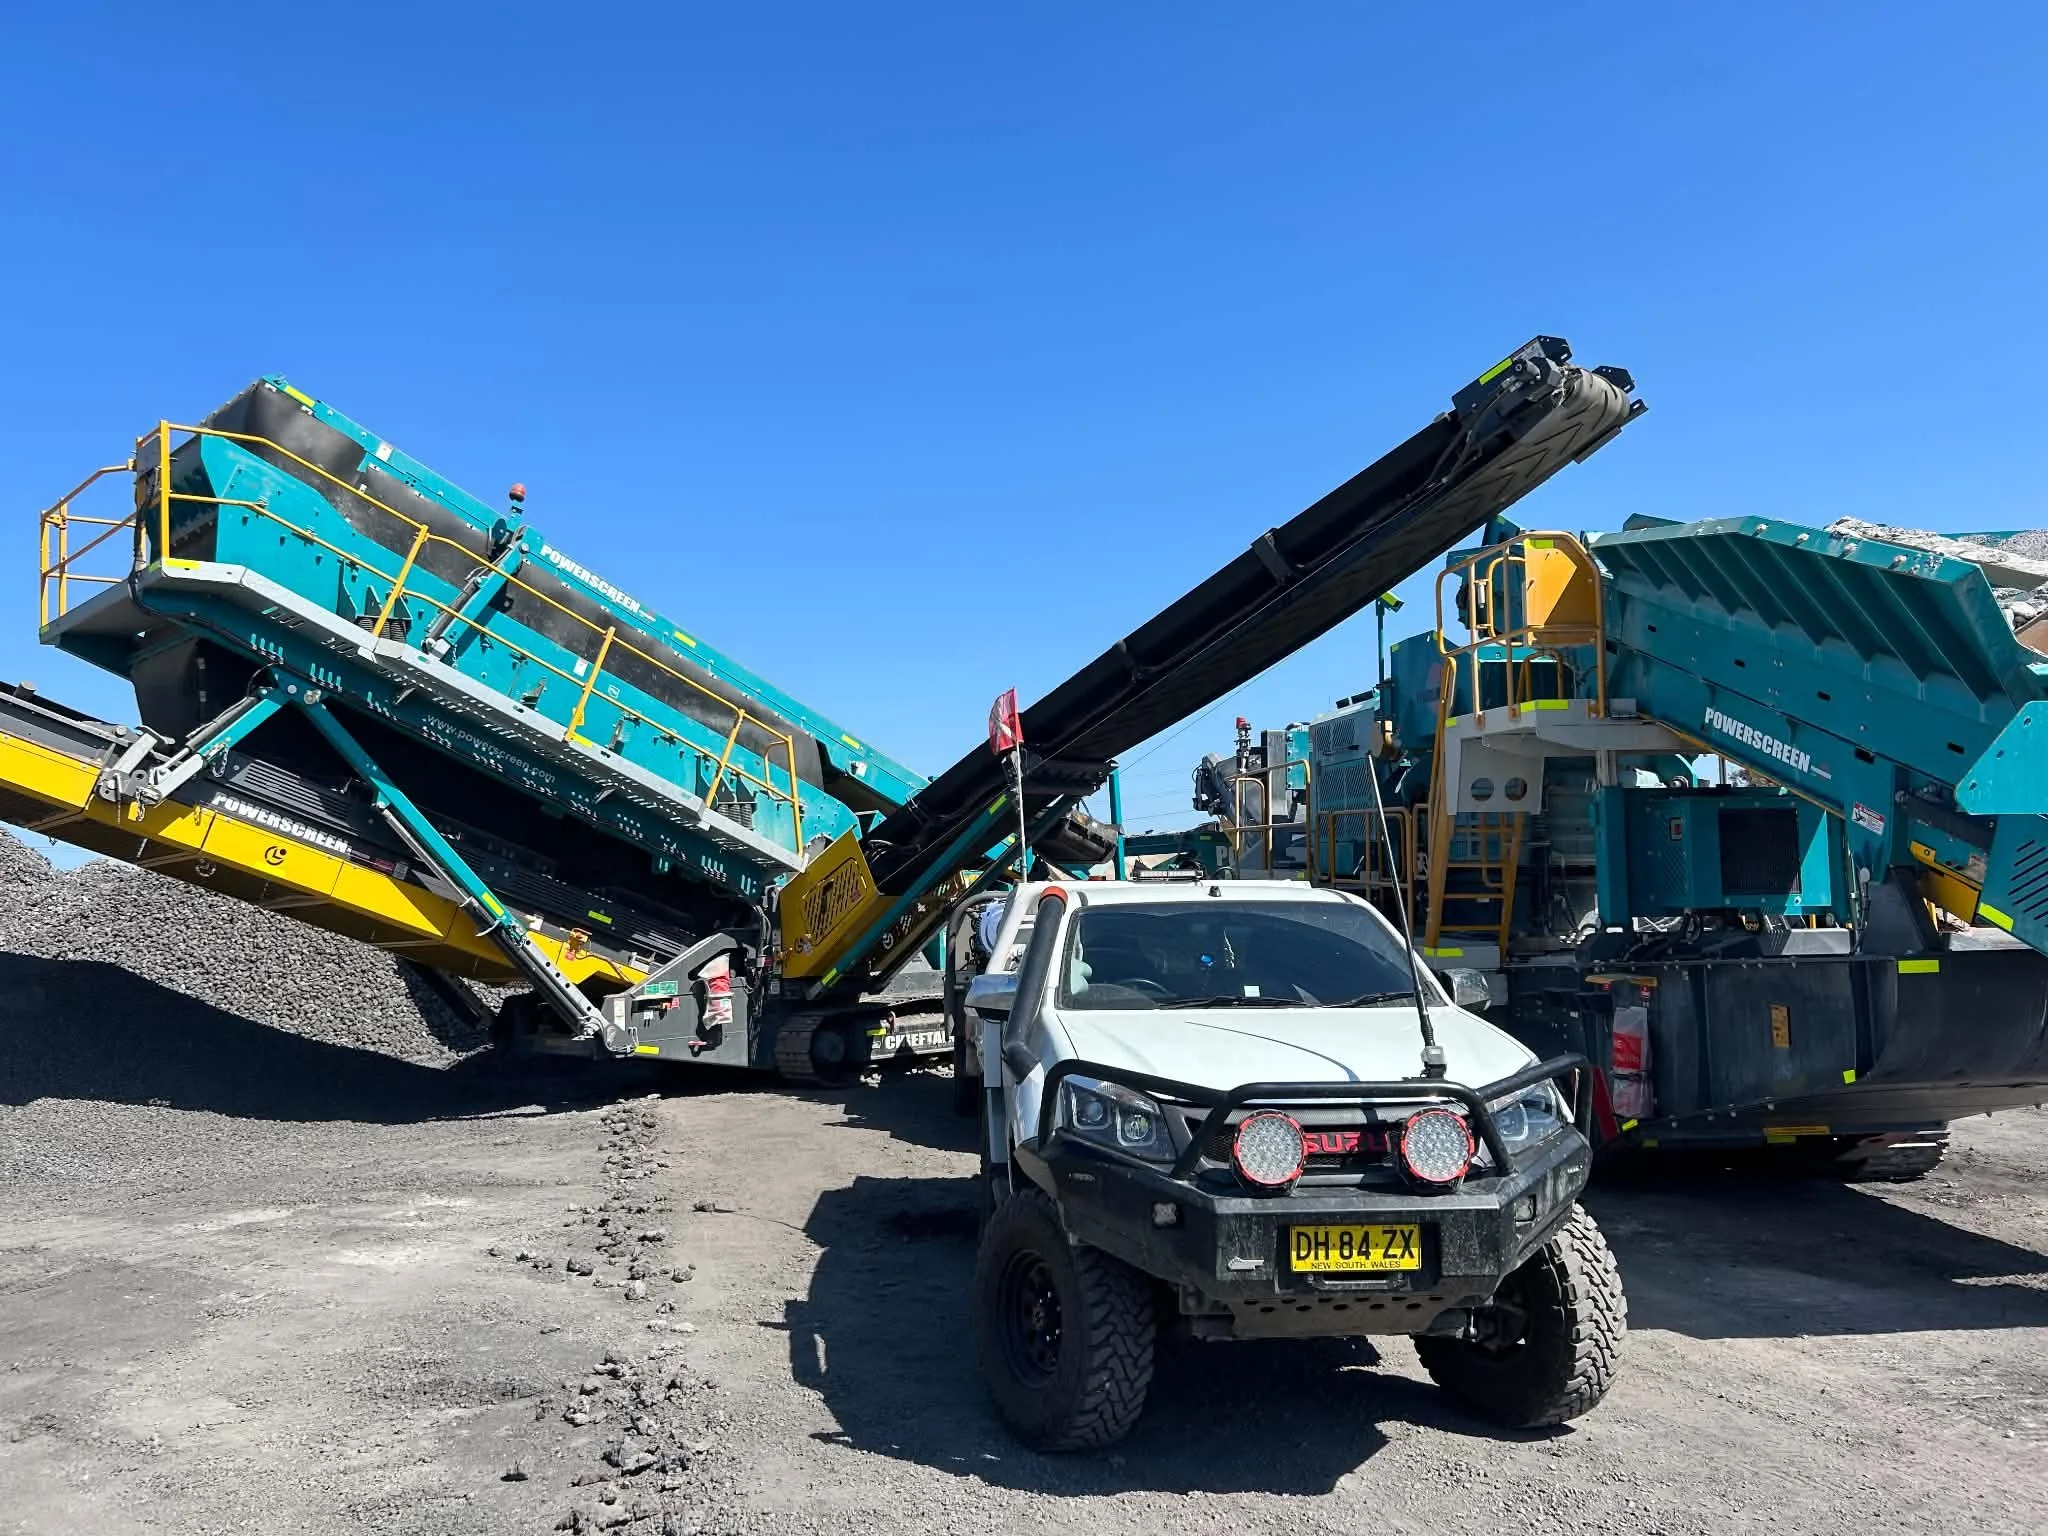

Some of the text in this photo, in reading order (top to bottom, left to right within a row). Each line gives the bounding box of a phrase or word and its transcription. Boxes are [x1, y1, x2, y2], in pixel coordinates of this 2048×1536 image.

[540, 543, 641, 613] POWERSCREEN
[426, 714, 556, 783] www.powerscreen.com
[1704, 706, 1811, 774] POWERSCREEN
[210, 791, 349, 854] POWERSCREEN
[885, 1030, 954, 1049] CHIEFTAI
[1296, 1229, 1415, 1261] DH 84 ZX
[1312, 1261, 1400, 1270] NEW SOUTH WALES
